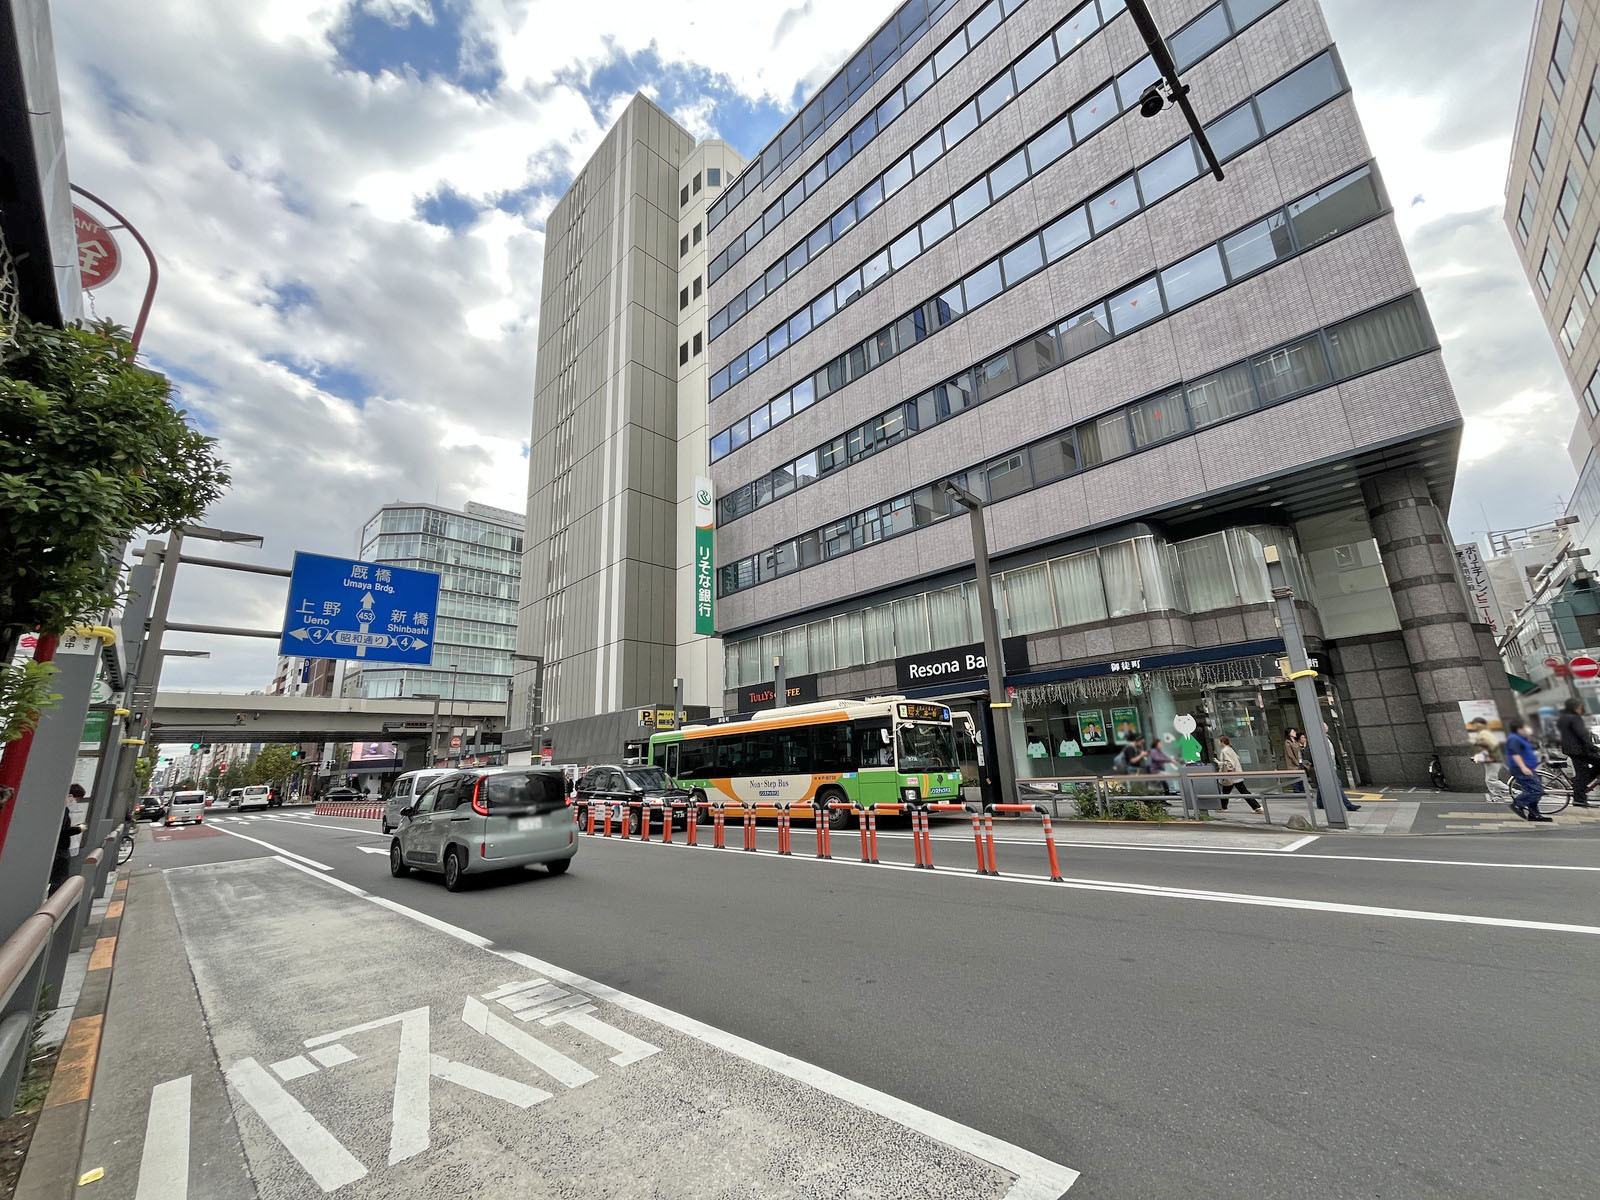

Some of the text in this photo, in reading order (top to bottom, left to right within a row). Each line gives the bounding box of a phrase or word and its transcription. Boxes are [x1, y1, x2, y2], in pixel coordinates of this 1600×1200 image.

[343, 578, 395, 594] Umaya Brdg.
[698, 546, 712, 618] りそな銀行
[296, 598, 342, 617] 上野
[303, 615, 330, 626] Ueno
[358, 612, 373, 621] 453
[390, 609, 429, 626] 新橋
[313, 629, 322, 640] 4
[387, 623, 429, 636] Shinbashi
[340, 633, 384, 645] 昭和通り
[400, 637, 408, 647] 4
[909, 654, 988, 679] Resona Ba
[778, 778, 789, 787] Bus
